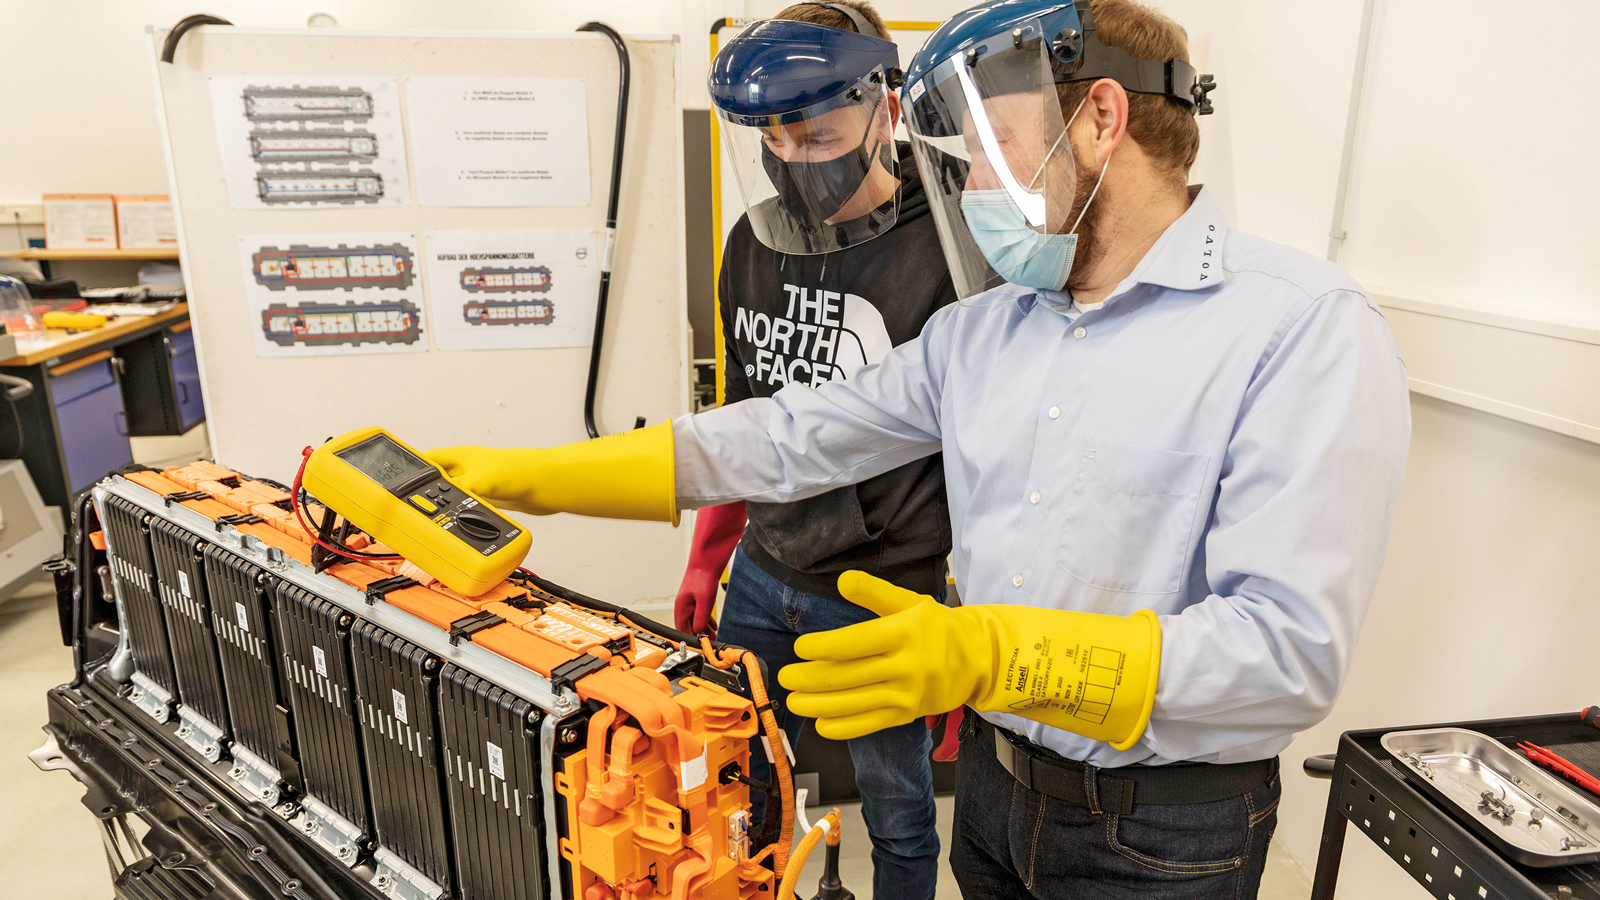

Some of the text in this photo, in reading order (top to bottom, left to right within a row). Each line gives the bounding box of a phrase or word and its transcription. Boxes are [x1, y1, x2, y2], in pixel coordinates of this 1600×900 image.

[1200, 224, 1215, 281] VOLVO
[783, 283, 841, 328] THE
[734, 306, 839, 364] NORTH
[756, 348, 832, 389] FACE
[1005, 646, 1020, 691] ELECTRICIAN
[1015, 666, 1027, 692] Ansell
[1041, 670, 1050, 698] CATEGORY
